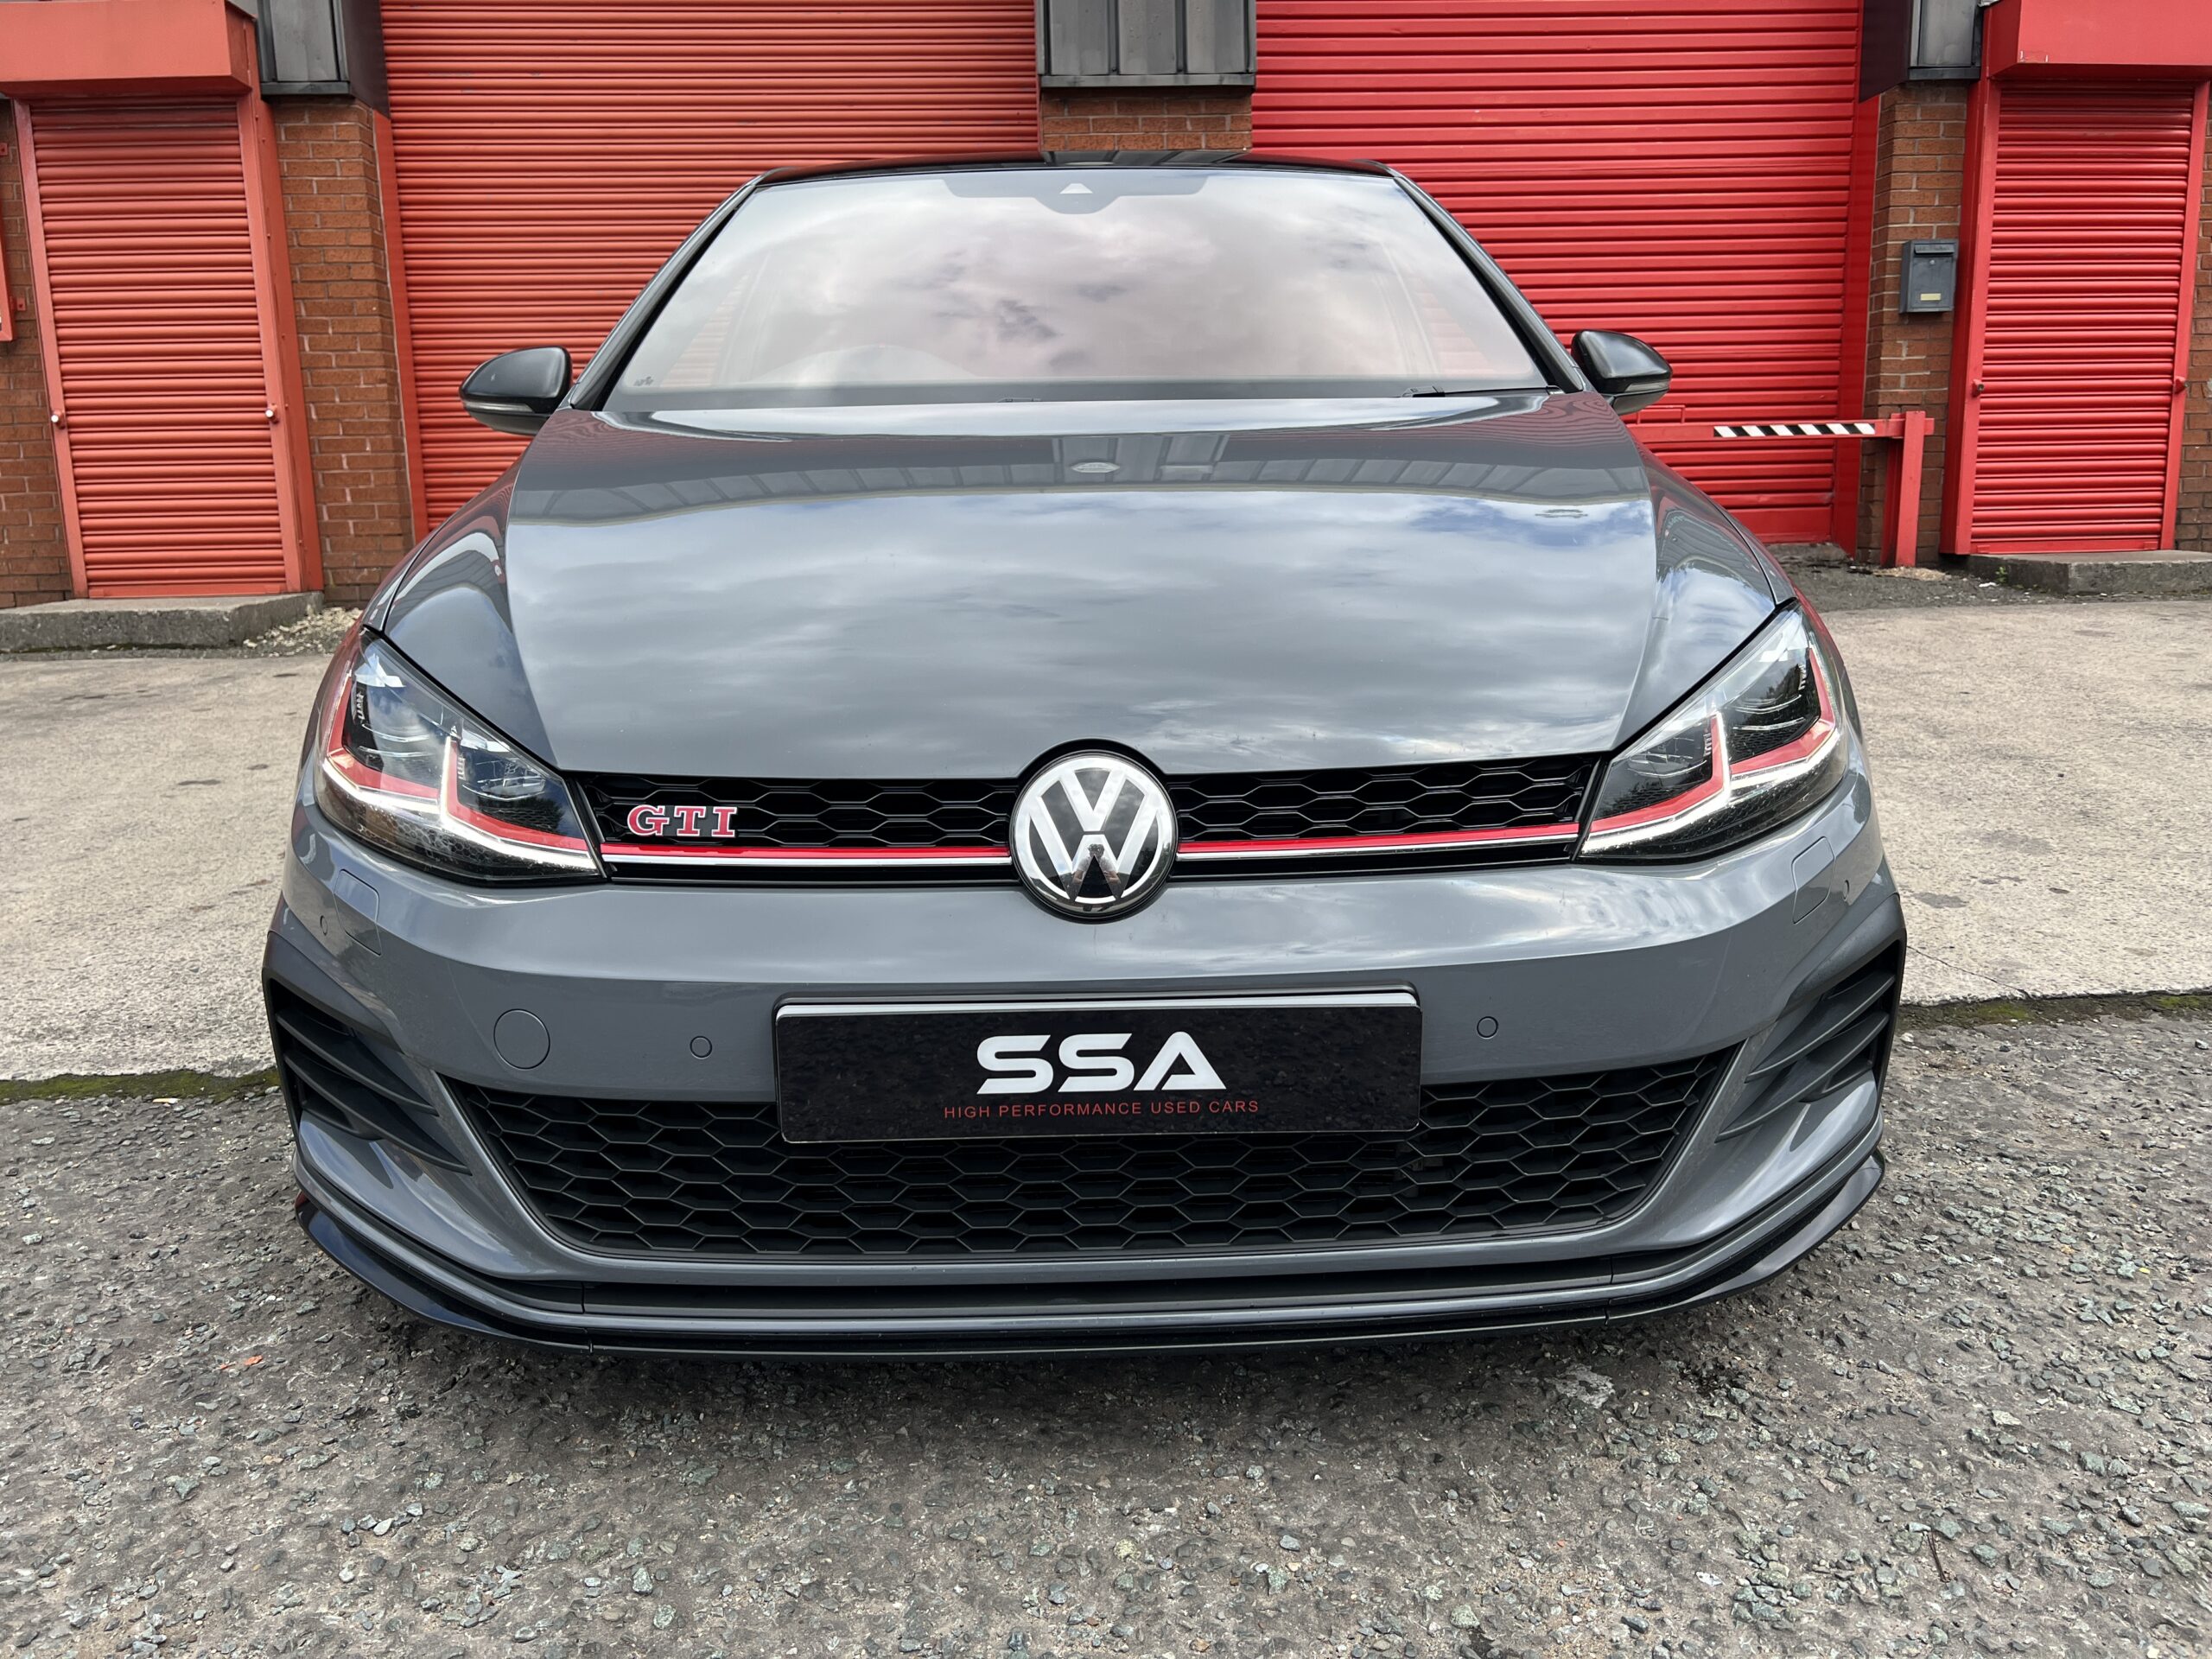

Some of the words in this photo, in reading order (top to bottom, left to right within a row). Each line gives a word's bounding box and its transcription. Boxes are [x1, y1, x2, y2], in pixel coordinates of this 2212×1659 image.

[626, 804, 738, 838] GTI
[1016, 756, 1172, 912] VW
[976, 1030, 1227, 1095] SSA
[944, 1105, 991, 1119] HIGH
[999, 1102, 1141, 1118] PERFORMANCE
[1150, 1101, 1201, 1115] USED
[1209, 1100, 1259, 1113] CARS
